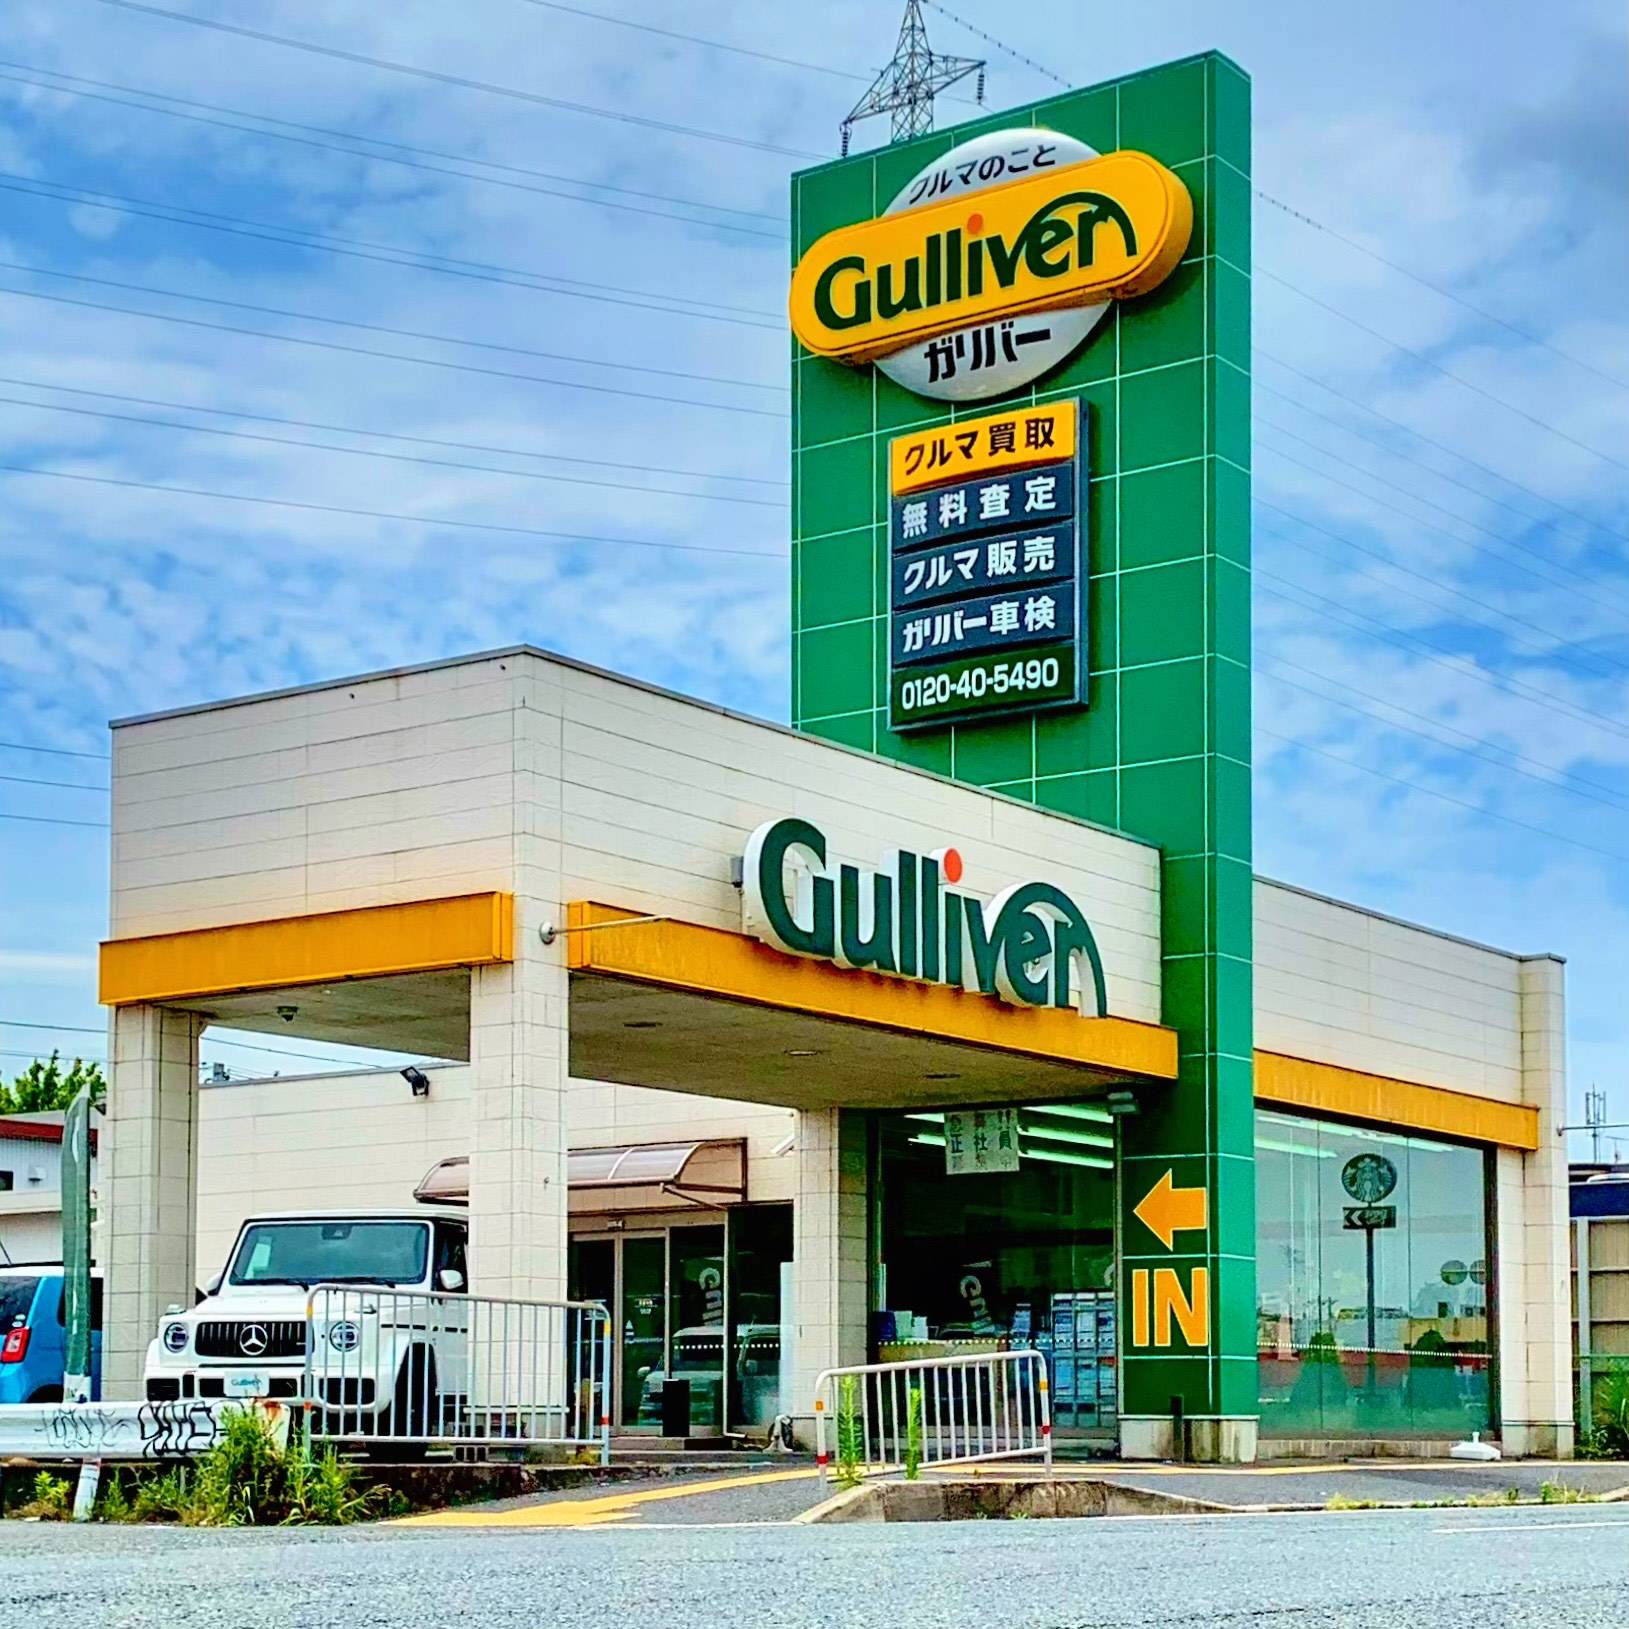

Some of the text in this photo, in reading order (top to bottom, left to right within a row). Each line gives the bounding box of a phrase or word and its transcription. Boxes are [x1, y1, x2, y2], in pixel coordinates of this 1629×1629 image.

[909, 144, 1057, 204] クルマのこと
[814, 190, 1137, 330] Gulliver
[924, 319, 1051, 383] ガリバー
[905, 417, 1055, 476] クルマ買取
[902, 476, 1057, 538] 無料査定
[904, 536, 1056, 595] クルマ販売
[902, 595, 1056, 653] ガリバー車検
[902, 657, 1059, 710] 0120-40-5490
[744, 817, 1107, 1018] Gulliver
[1132, 1266, 1209, 1347] IN
